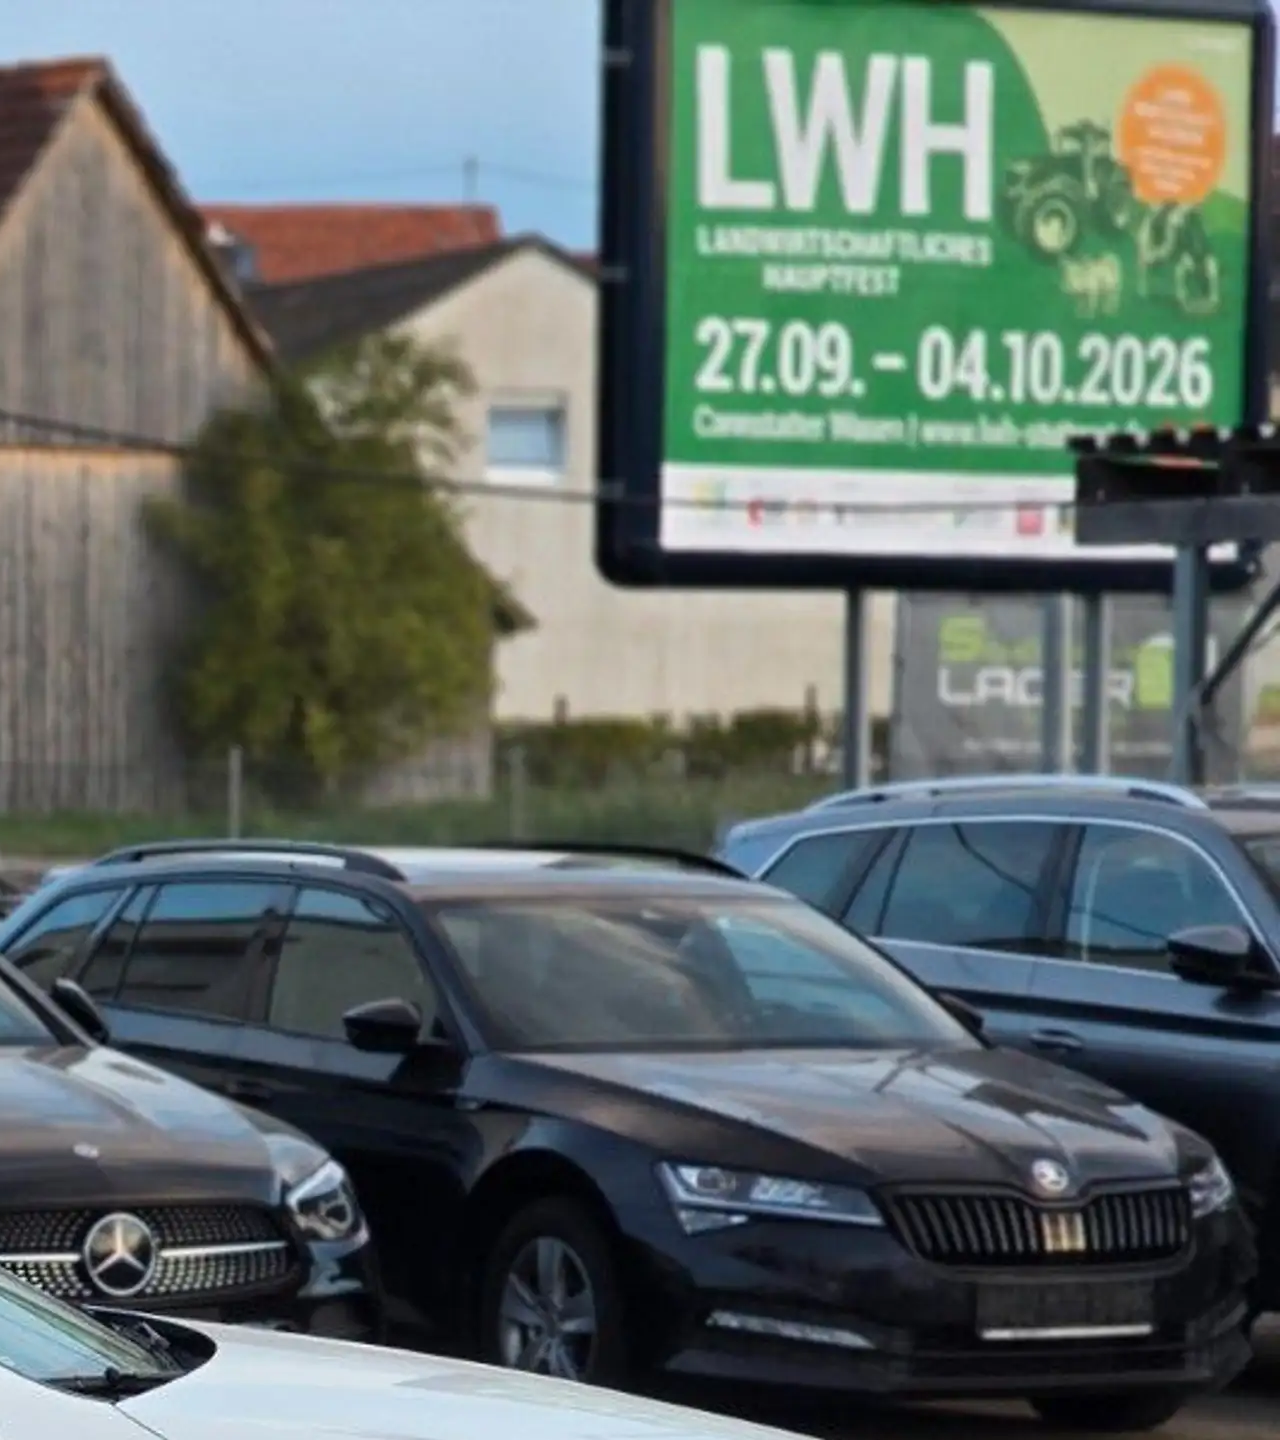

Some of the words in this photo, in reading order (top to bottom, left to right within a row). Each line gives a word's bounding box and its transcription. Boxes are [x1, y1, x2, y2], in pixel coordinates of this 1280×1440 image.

[695, 44, 995, 220] LWH
[695, 316, 865, 396] 27.09.
[918, 326, 1214, 409] 04.10.2026
